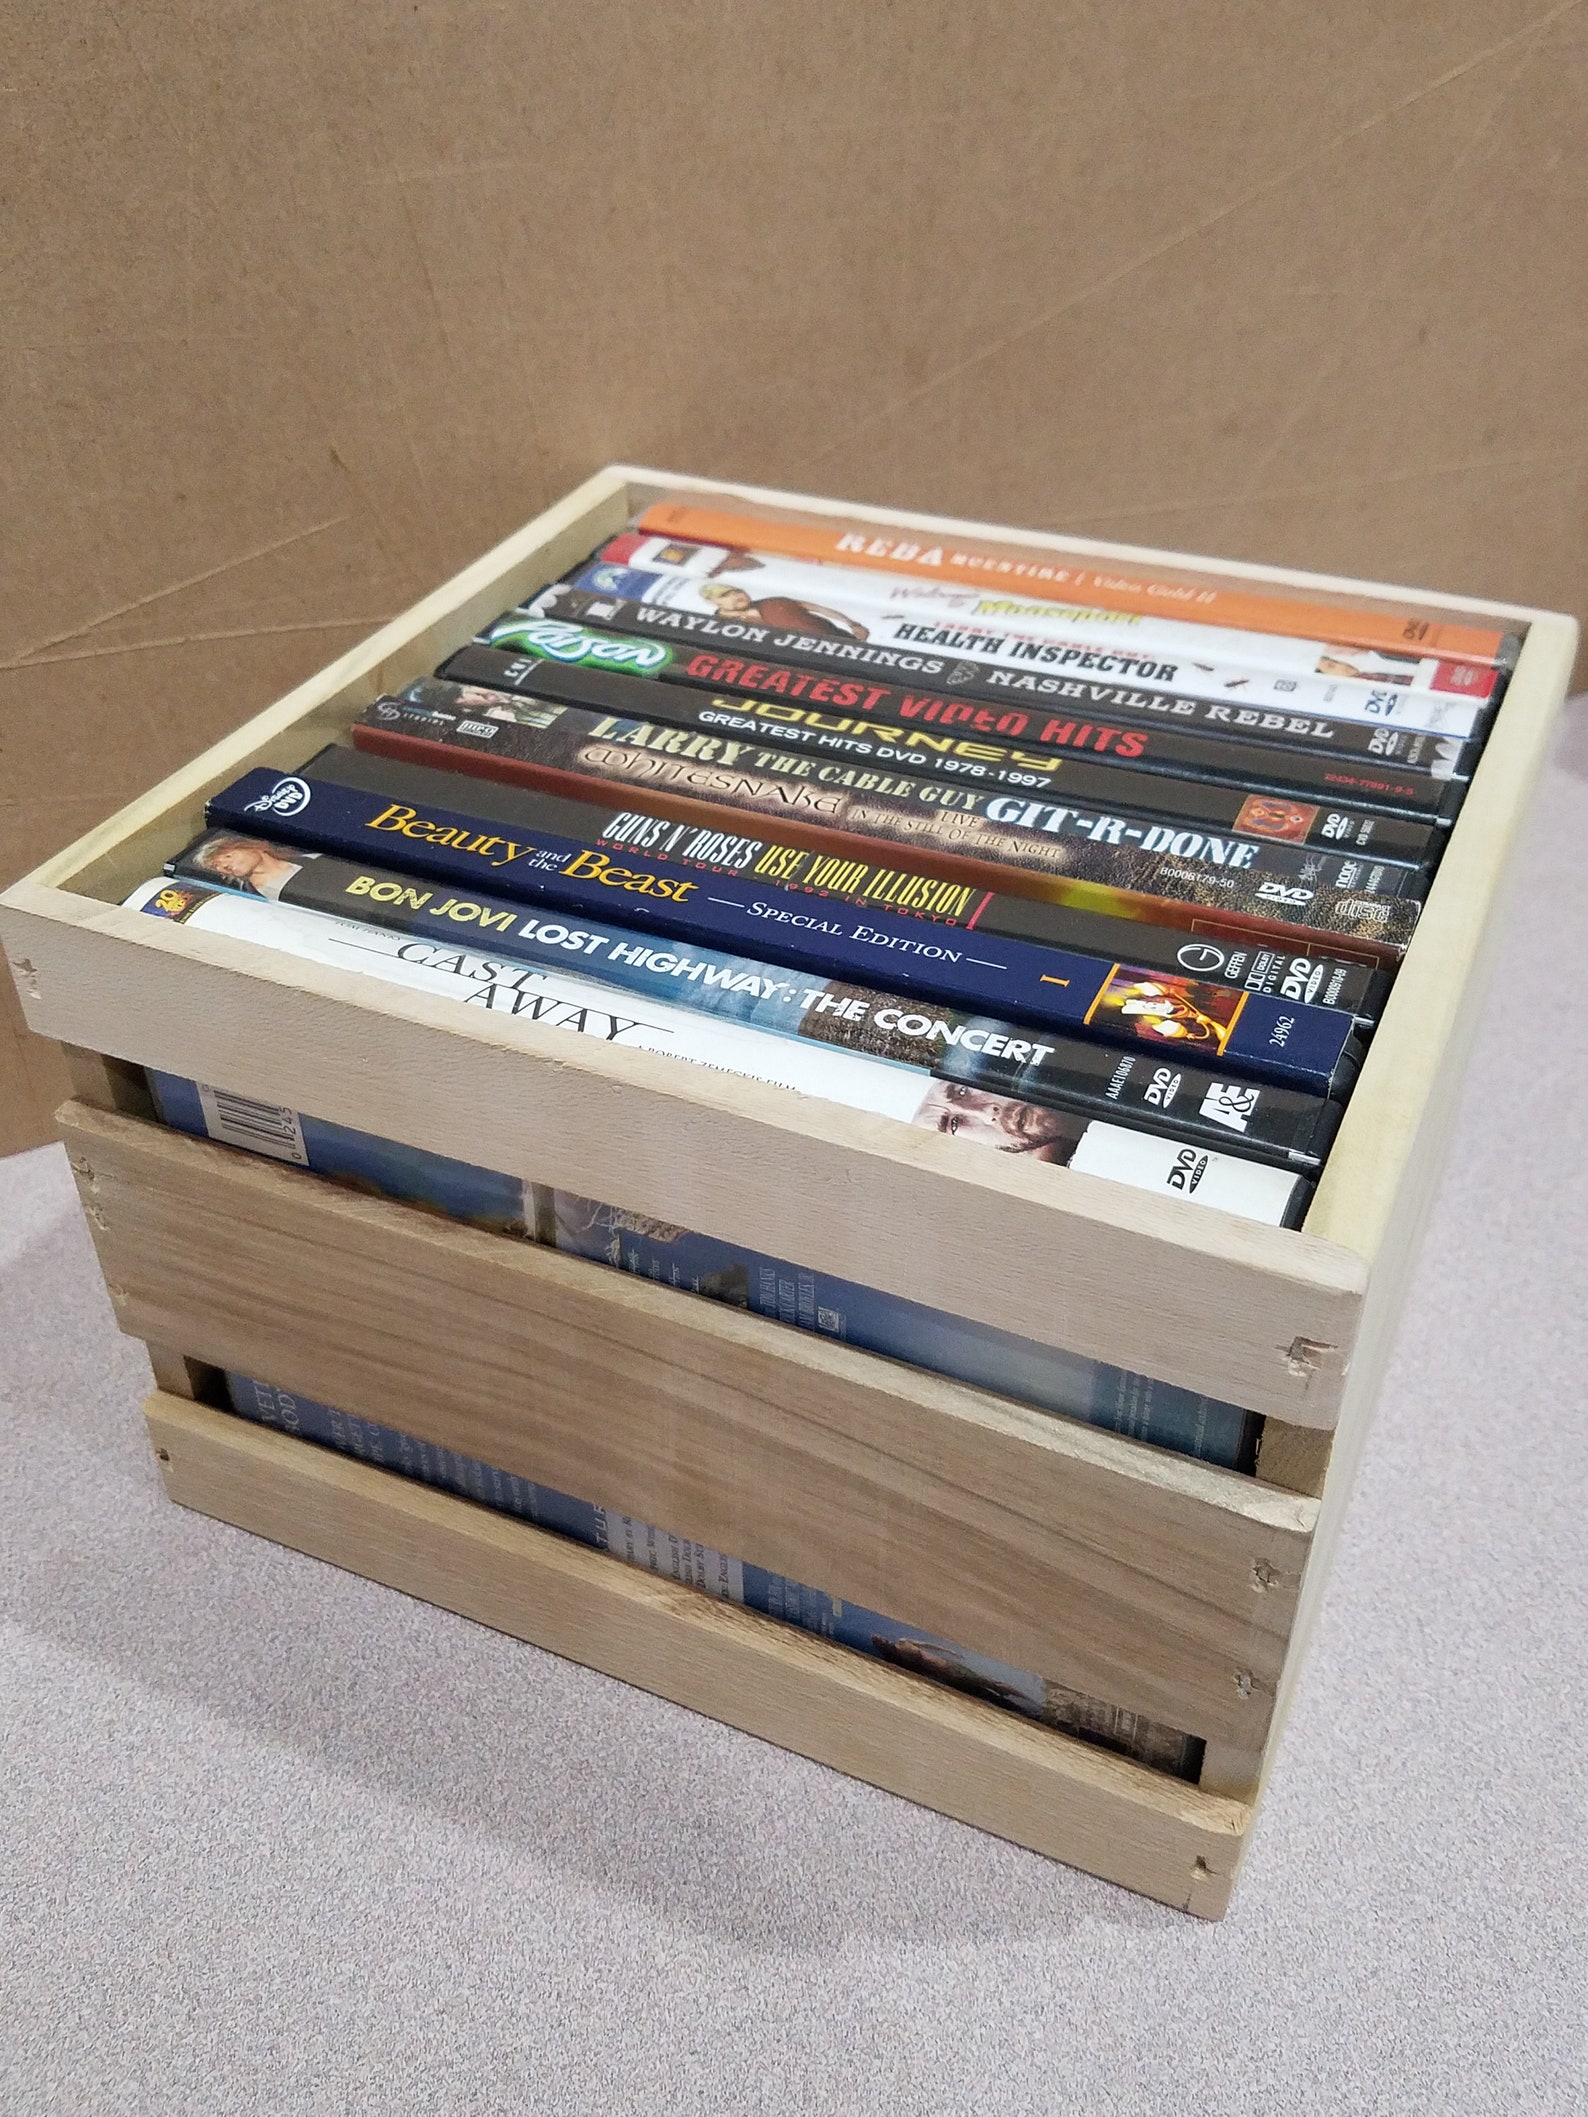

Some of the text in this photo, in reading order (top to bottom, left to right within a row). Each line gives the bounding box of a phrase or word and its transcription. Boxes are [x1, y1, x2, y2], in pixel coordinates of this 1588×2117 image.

[636, 606, 1334, 739] WAYLON JENNINGS NASHVILLE REBEL
[894, 623, 1178, 681] HEALTH INSPECTOR
[685, 653, 1149, 758] GREATEST VIDEO HITS
[699, 711, 1051, 789] GREATEST HITS DVD 1978-1997
[711, 699, 1062, 772] JOURNEY
[1368, 728, 1390, 755] DVD
[274, 791, 304, 811] DVD
[588, 716, 755, 766] LARRY
[754, 750, 816, 778] THE
[818, 763, 916, 798] CABLE
[918, 786, 984, 811] GUY
[985, 797, 1260, 869] GIT-R-DONE
[365, 803, 538, 867] Beauty
[852, 808, 1062, 858] IN THE STILL OF THE NIGHT
[940, 811, 981, 828] LIVE
[1321, 813, 1341, 838] DVD
[528, 857, 560, 872] the
[535, 849, 573, 864] and
[559, 849, 699, 902] Beast
[602, 811, 668, 848] GUNS
[754, 844, 808, 880] USE
[803, 855, 868, 893] YOUR
[864, 869, 977, 917] ILLUSION
[595, 839, 958, 927] WORLD TOUR 1992 IN TOKYO
[1258, 882, 1314, 900] DVD
[746, 902, 963, 964] SPECIAL EDITION
[345, 875, 433, 911] BON
[429, 898, 519, 932] JOVI
[518, 918, 609, 954] LOST
[800, 988, 870, 1022] THE
[874, 1007, 1056, 1067] CONCERT
[396, 943, 548, 989] CAST
[1224, 951, 1248, 979] GEFFEN
[1256, 953, 1273, 972] DOLBY
[1262, 954, 1286, 993] DIGITAL
[1280, 957, 1311, 1001] DVD
[463, 984, 640, 1041] AWAY
[1269, 1015, 1295, 1048] 24962
[1144, 1067, 1173, 1105] DVD
[1166, 1148, 1197, 1190] DVD
